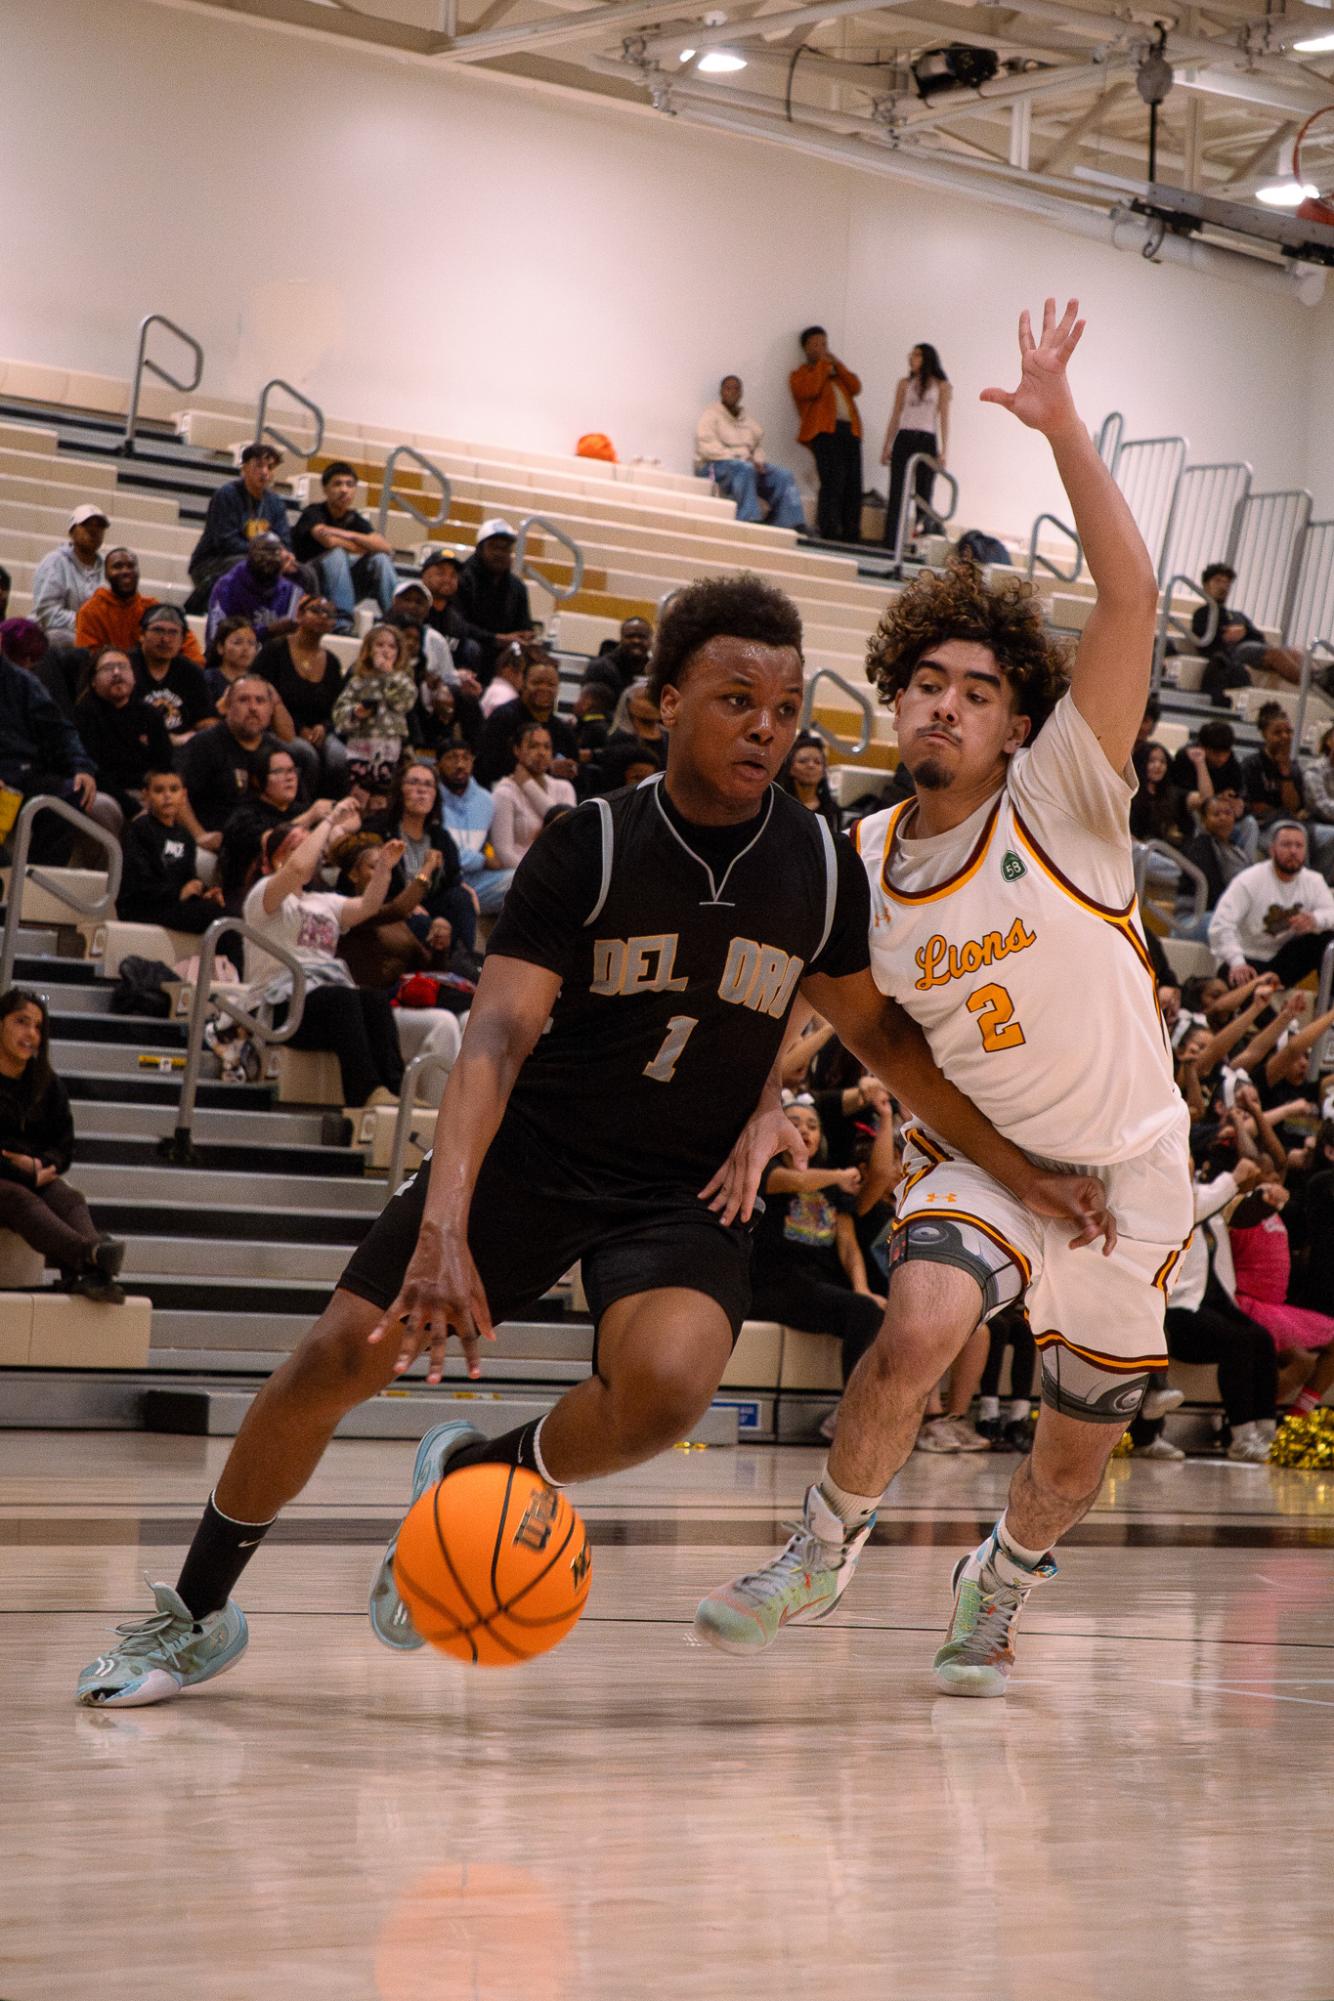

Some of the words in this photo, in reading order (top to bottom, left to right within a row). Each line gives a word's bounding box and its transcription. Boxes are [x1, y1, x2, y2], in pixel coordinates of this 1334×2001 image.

[1006, 861, 1021, 877] 58
[589, 933, 689, 996] DEL
[914, 917, 1037, 991] Lions
[641, 1014, 699, 1083] 1
[965, 982, 1026, 1053] 2
